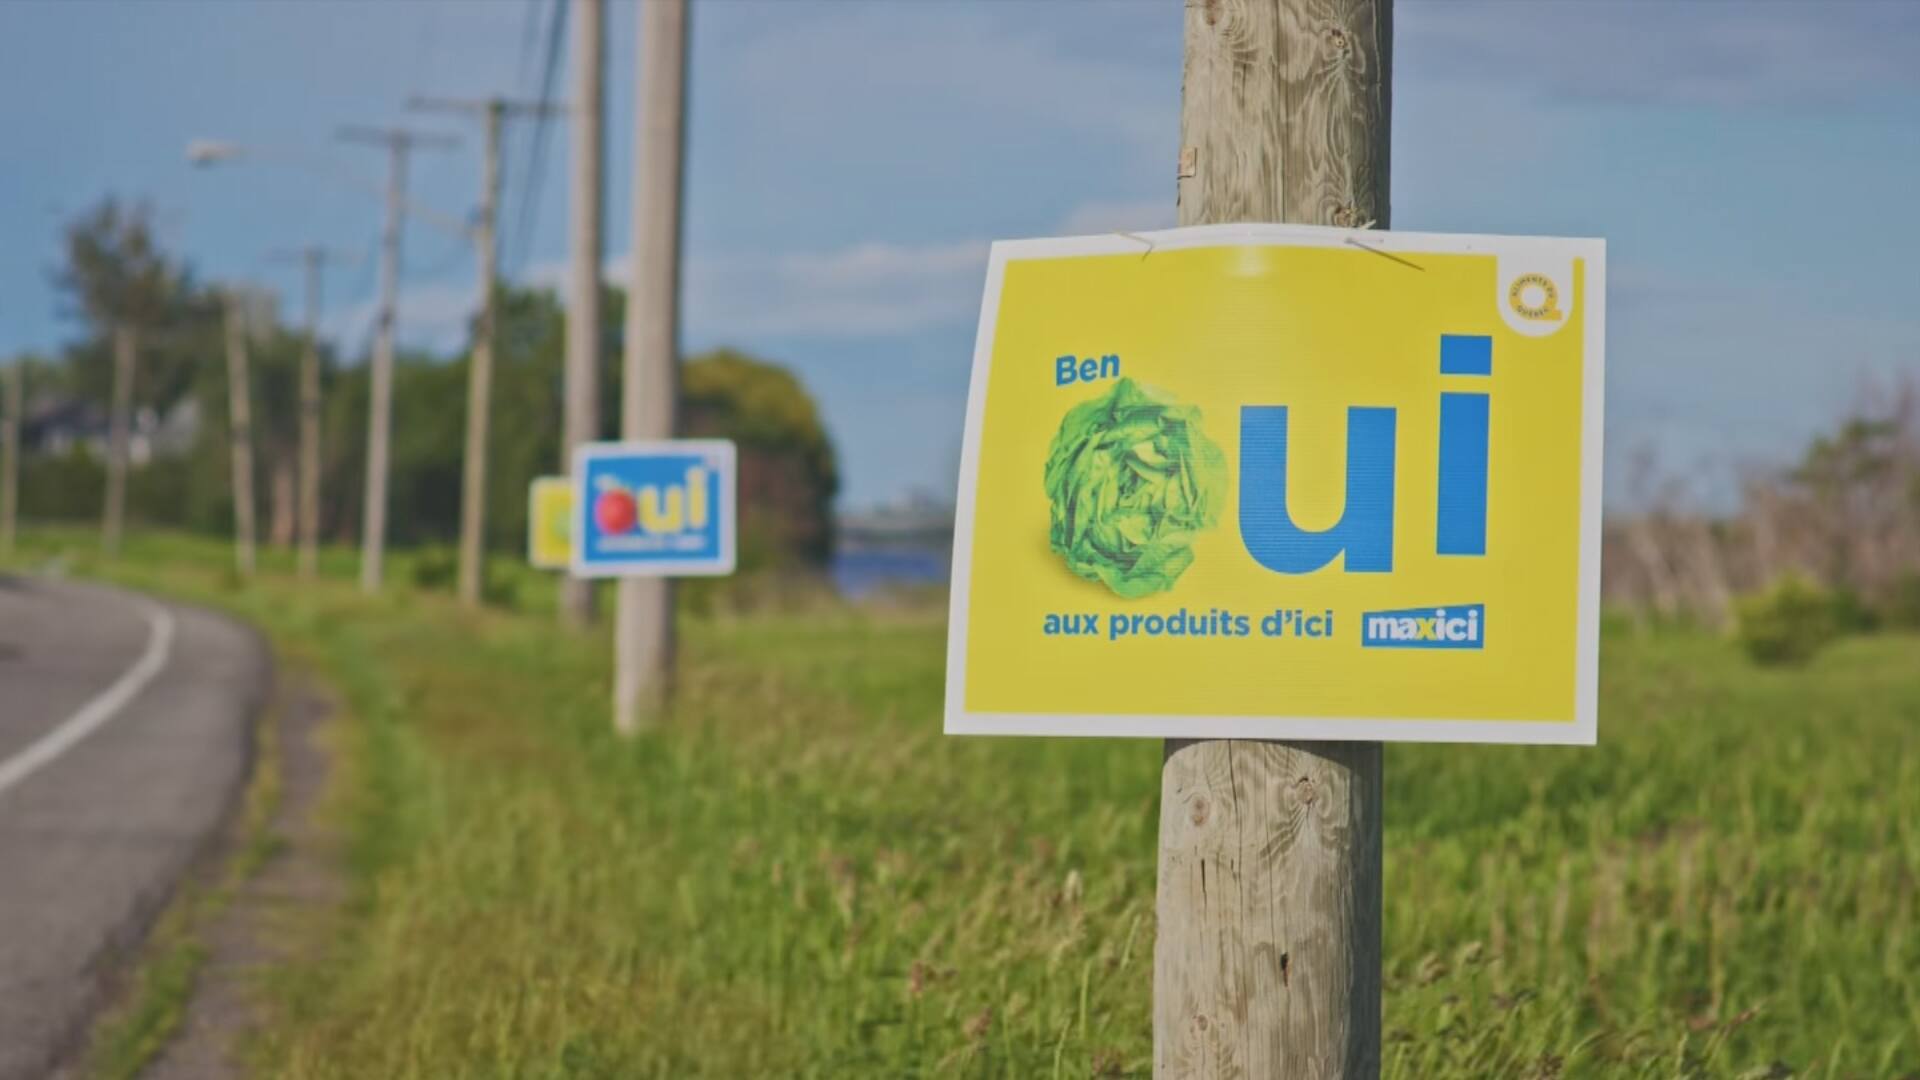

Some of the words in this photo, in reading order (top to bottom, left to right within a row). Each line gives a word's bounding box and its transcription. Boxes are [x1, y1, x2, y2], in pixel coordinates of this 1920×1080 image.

[1056, 354, 1120, 386] Ben
[1043, 612, 1099, 635] aux
[1110, 609, 1249, 640] produits
[1368, 609, 1477, 641] maxici
